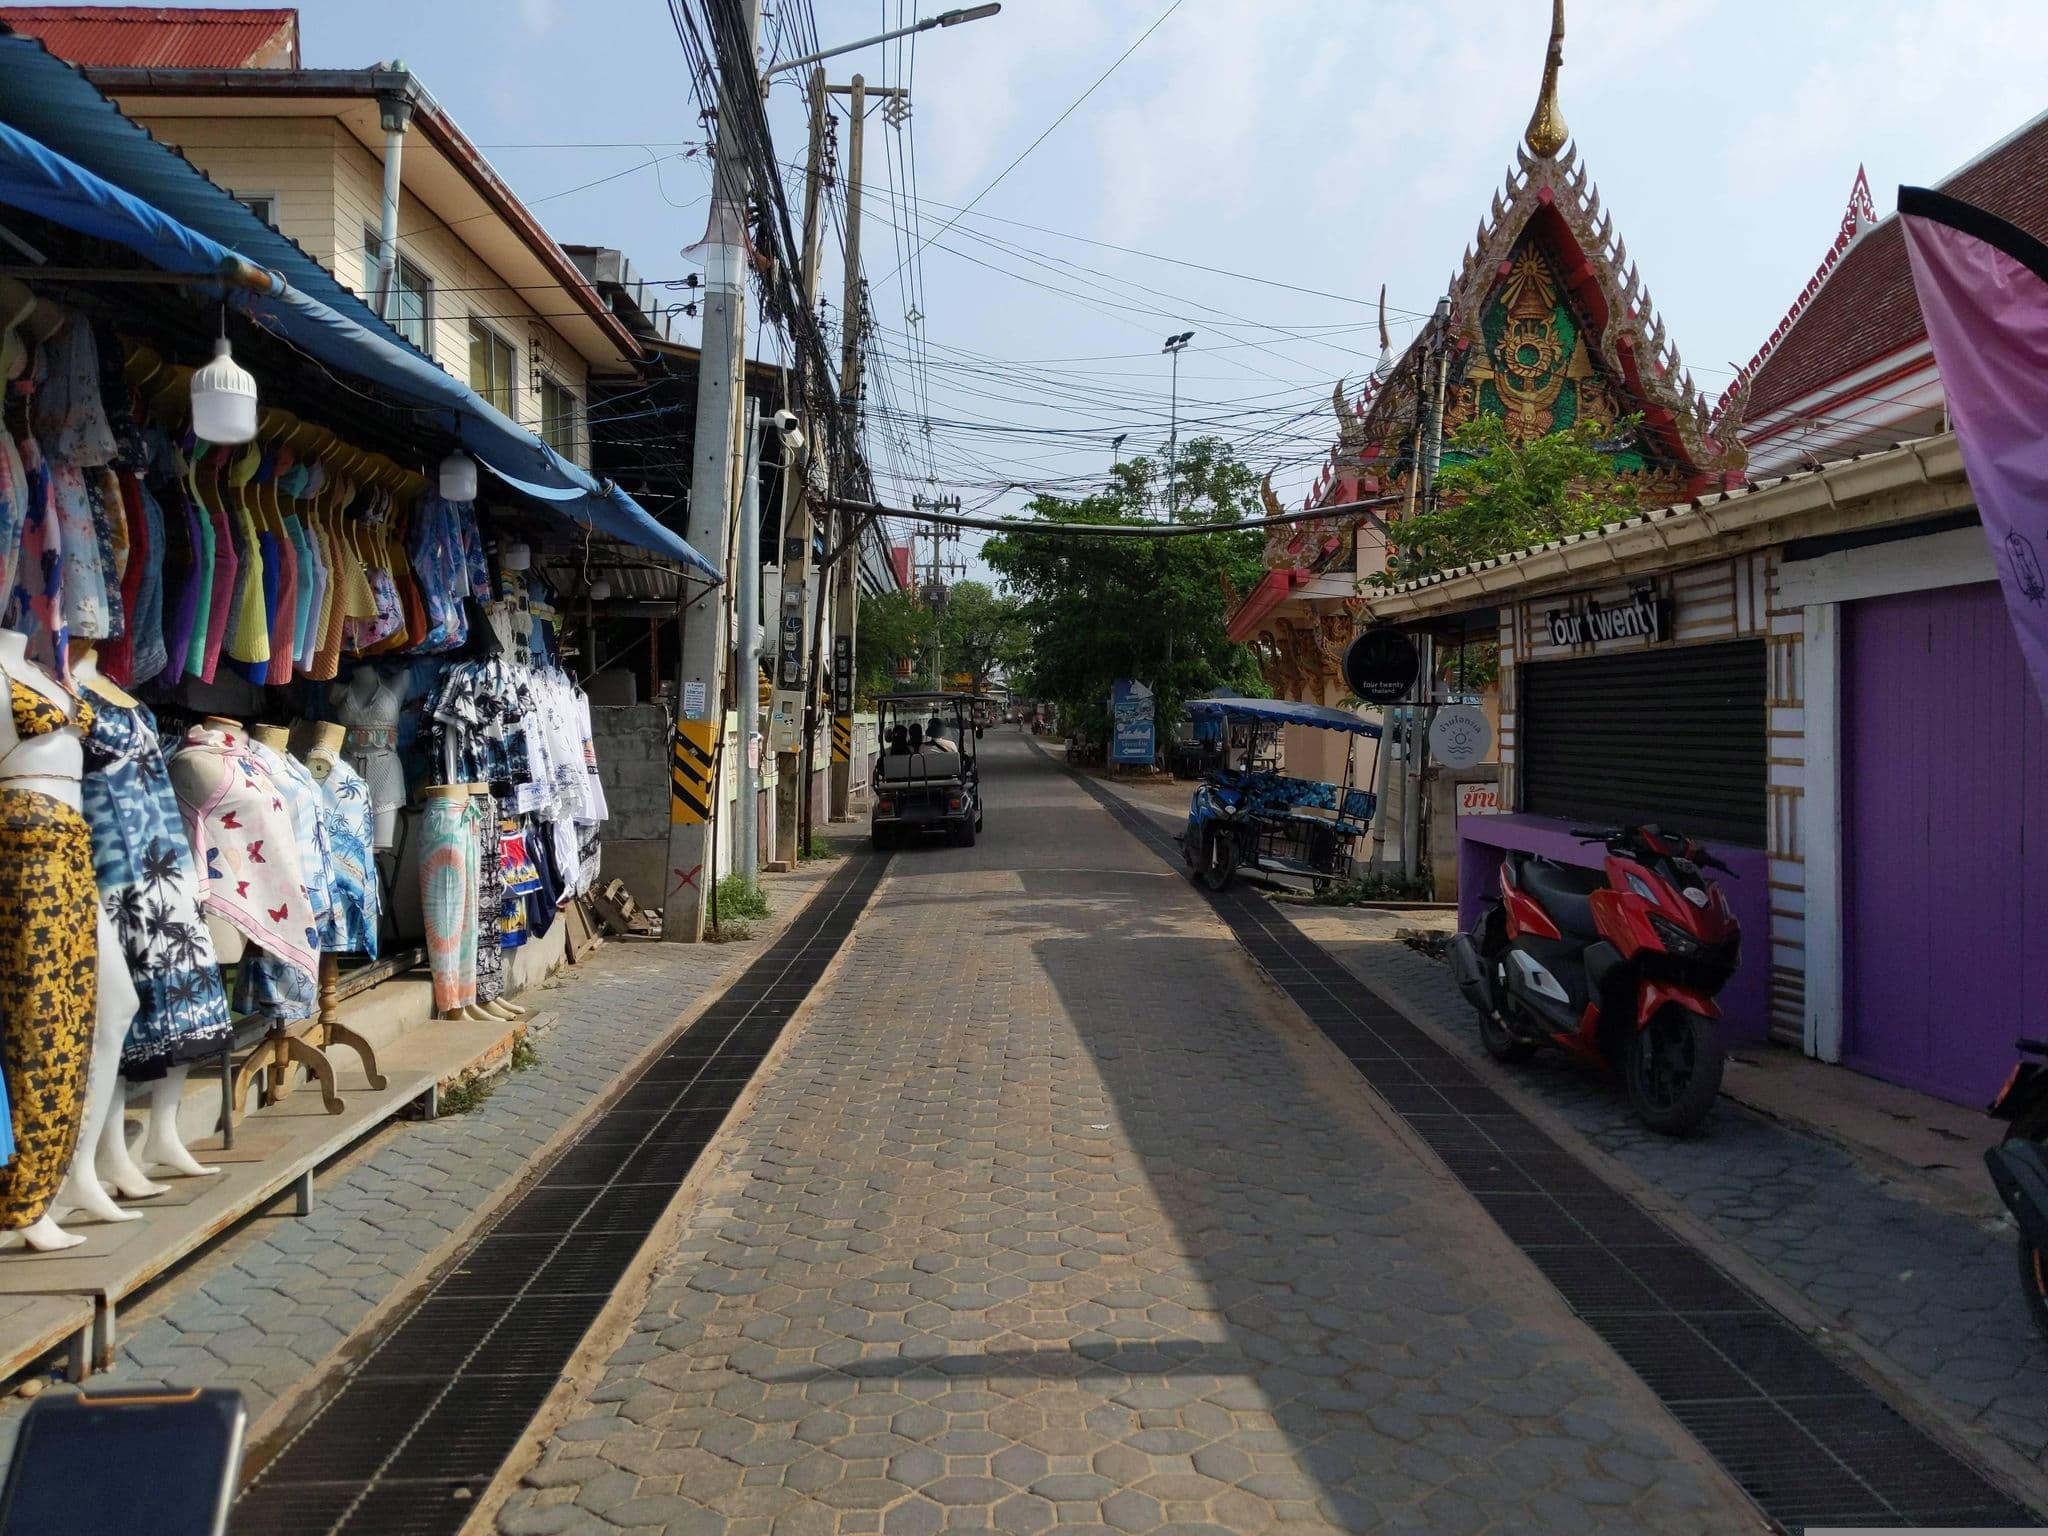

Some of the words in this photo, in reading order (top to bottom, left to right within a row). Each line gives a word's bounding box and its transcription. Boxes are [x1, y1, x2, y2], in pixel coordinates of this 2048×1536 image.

[1546, 611, 1582, 646] four
[1585, 597, 1659, 642] twenty
[1363, 681, 1378, 689] four
[1379, 681, 1404, 690] twenty
